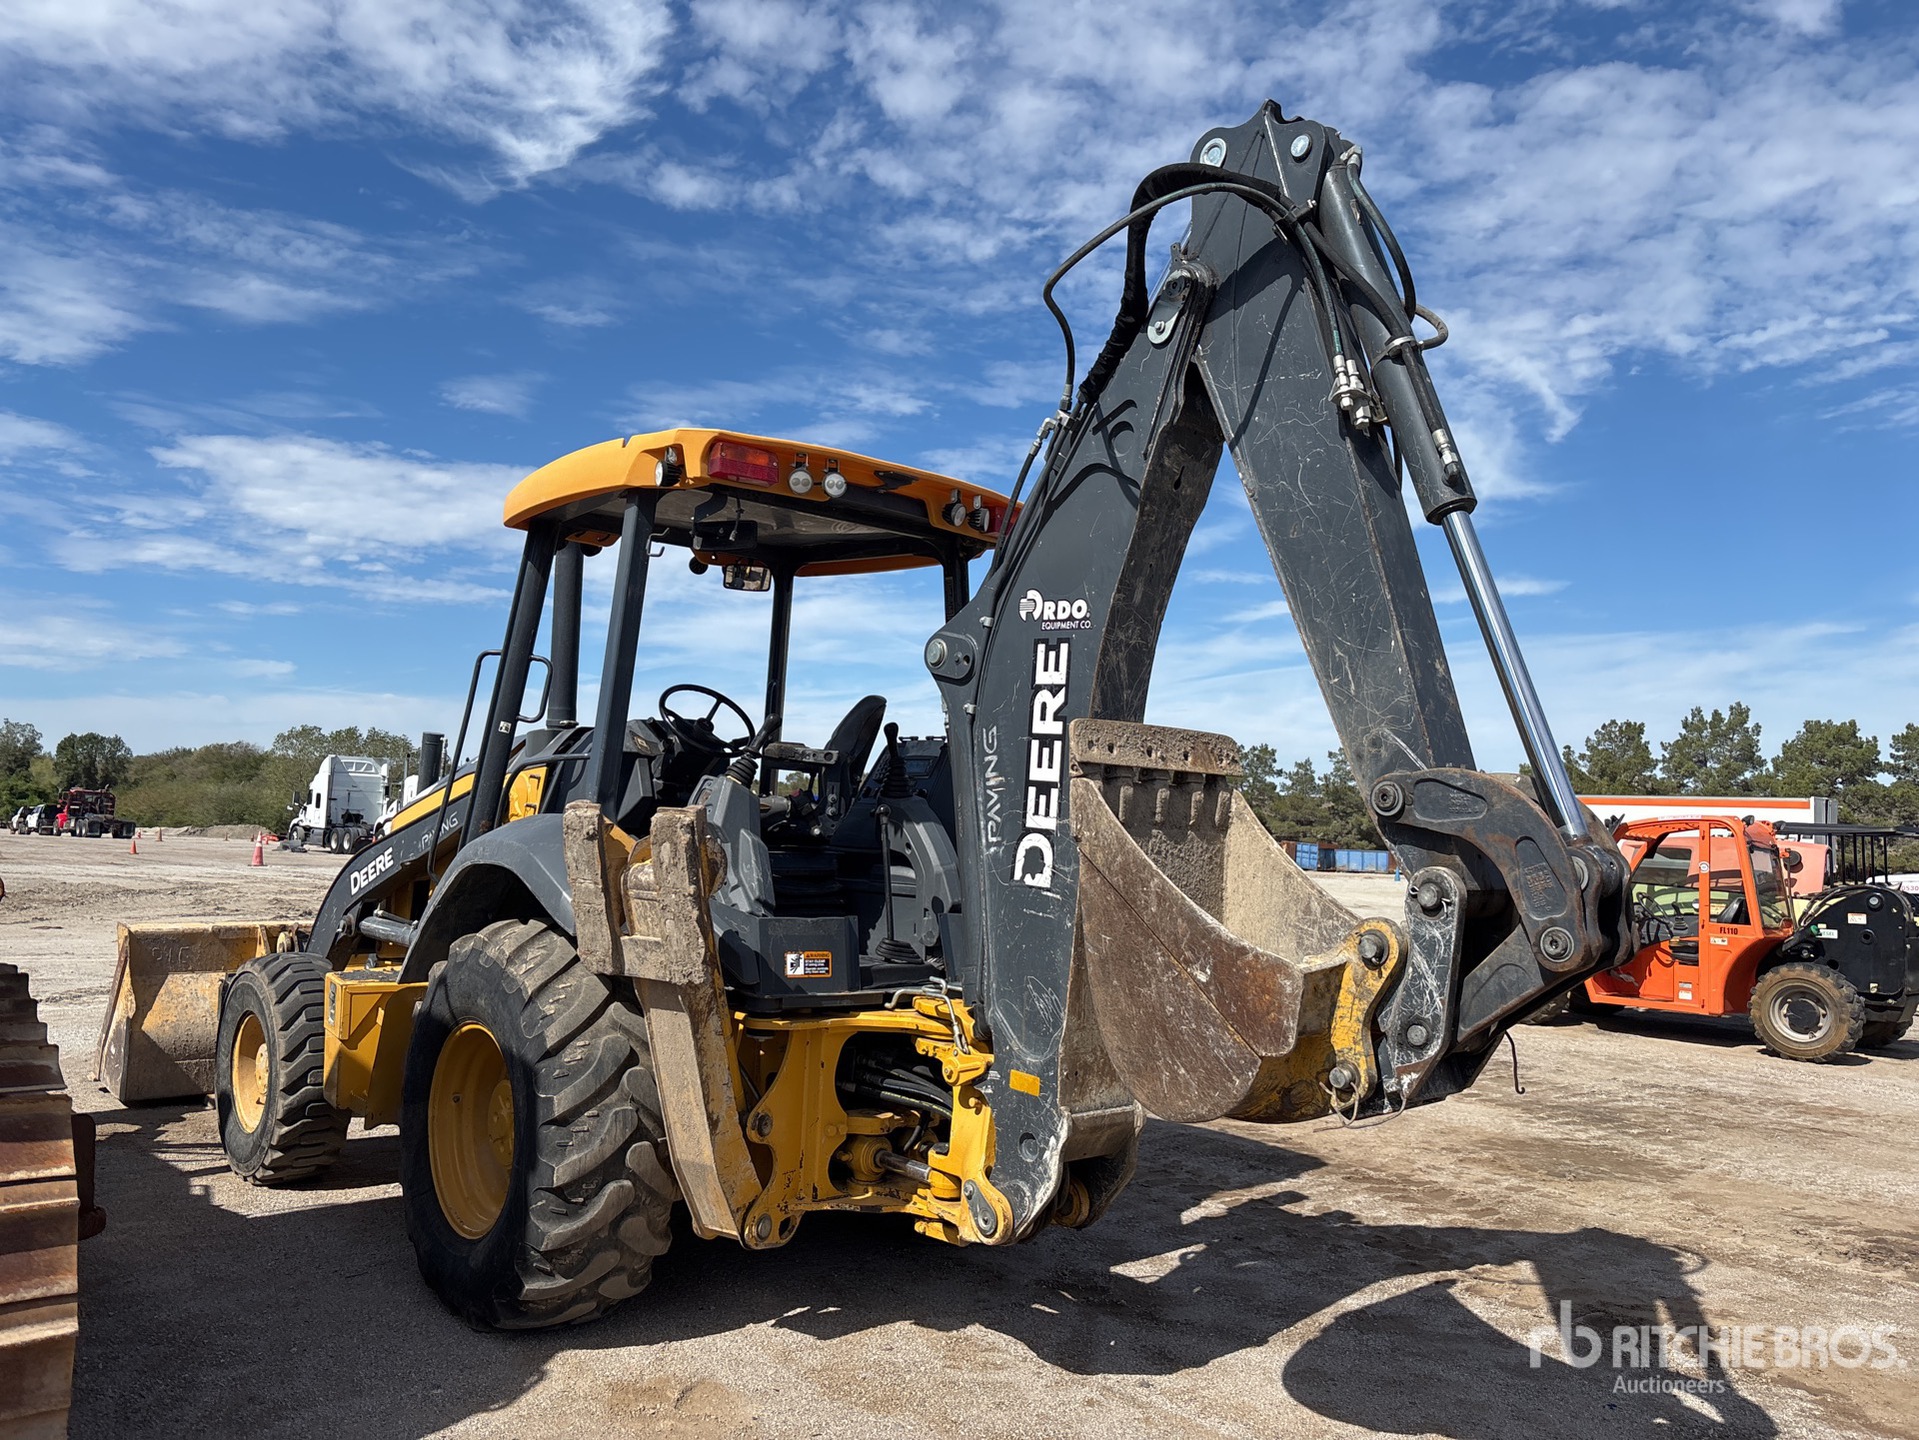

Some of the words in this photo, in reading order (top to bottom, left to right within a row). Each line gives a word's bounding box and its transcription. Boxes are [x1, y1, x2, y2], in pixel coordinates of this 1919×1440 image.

[1041, 620, 1079, 630] EQUIPMENT
[982, 725, 1003, 843] PAVING
[1013, 642, 1069, 888] DEERE
[421, 811, 459, 850] PNG
[350, 847, 394, 896] DEERE
[1719, 926, 1738, 935] FL110
